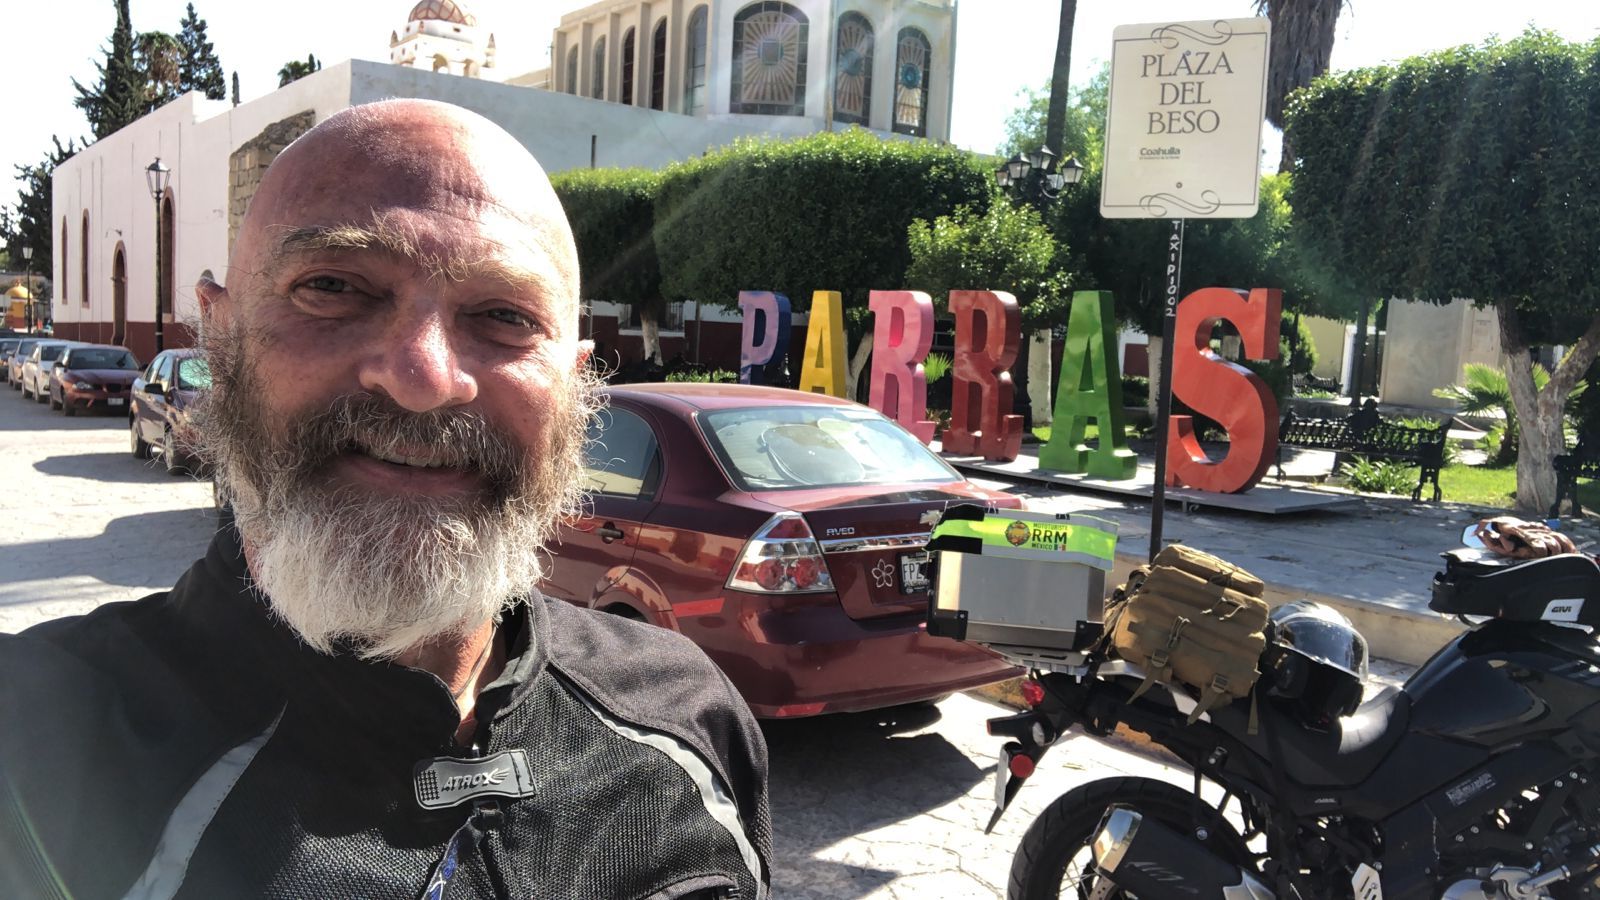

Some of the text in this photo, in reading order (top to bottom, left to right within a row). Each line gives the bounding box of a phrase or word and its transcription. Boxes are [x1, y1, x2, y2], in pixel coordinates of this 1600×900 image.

[1140, 51, 1234, 78] PLAZA
[1159, 81, 1211, 106] DEL
[1147, 110, 1220, 135] BESO
[738, 287, 1282, 495] PARRAS
[826, 526, 855, 536] AVEO
[1032, 528, 1067, 545] RRM
